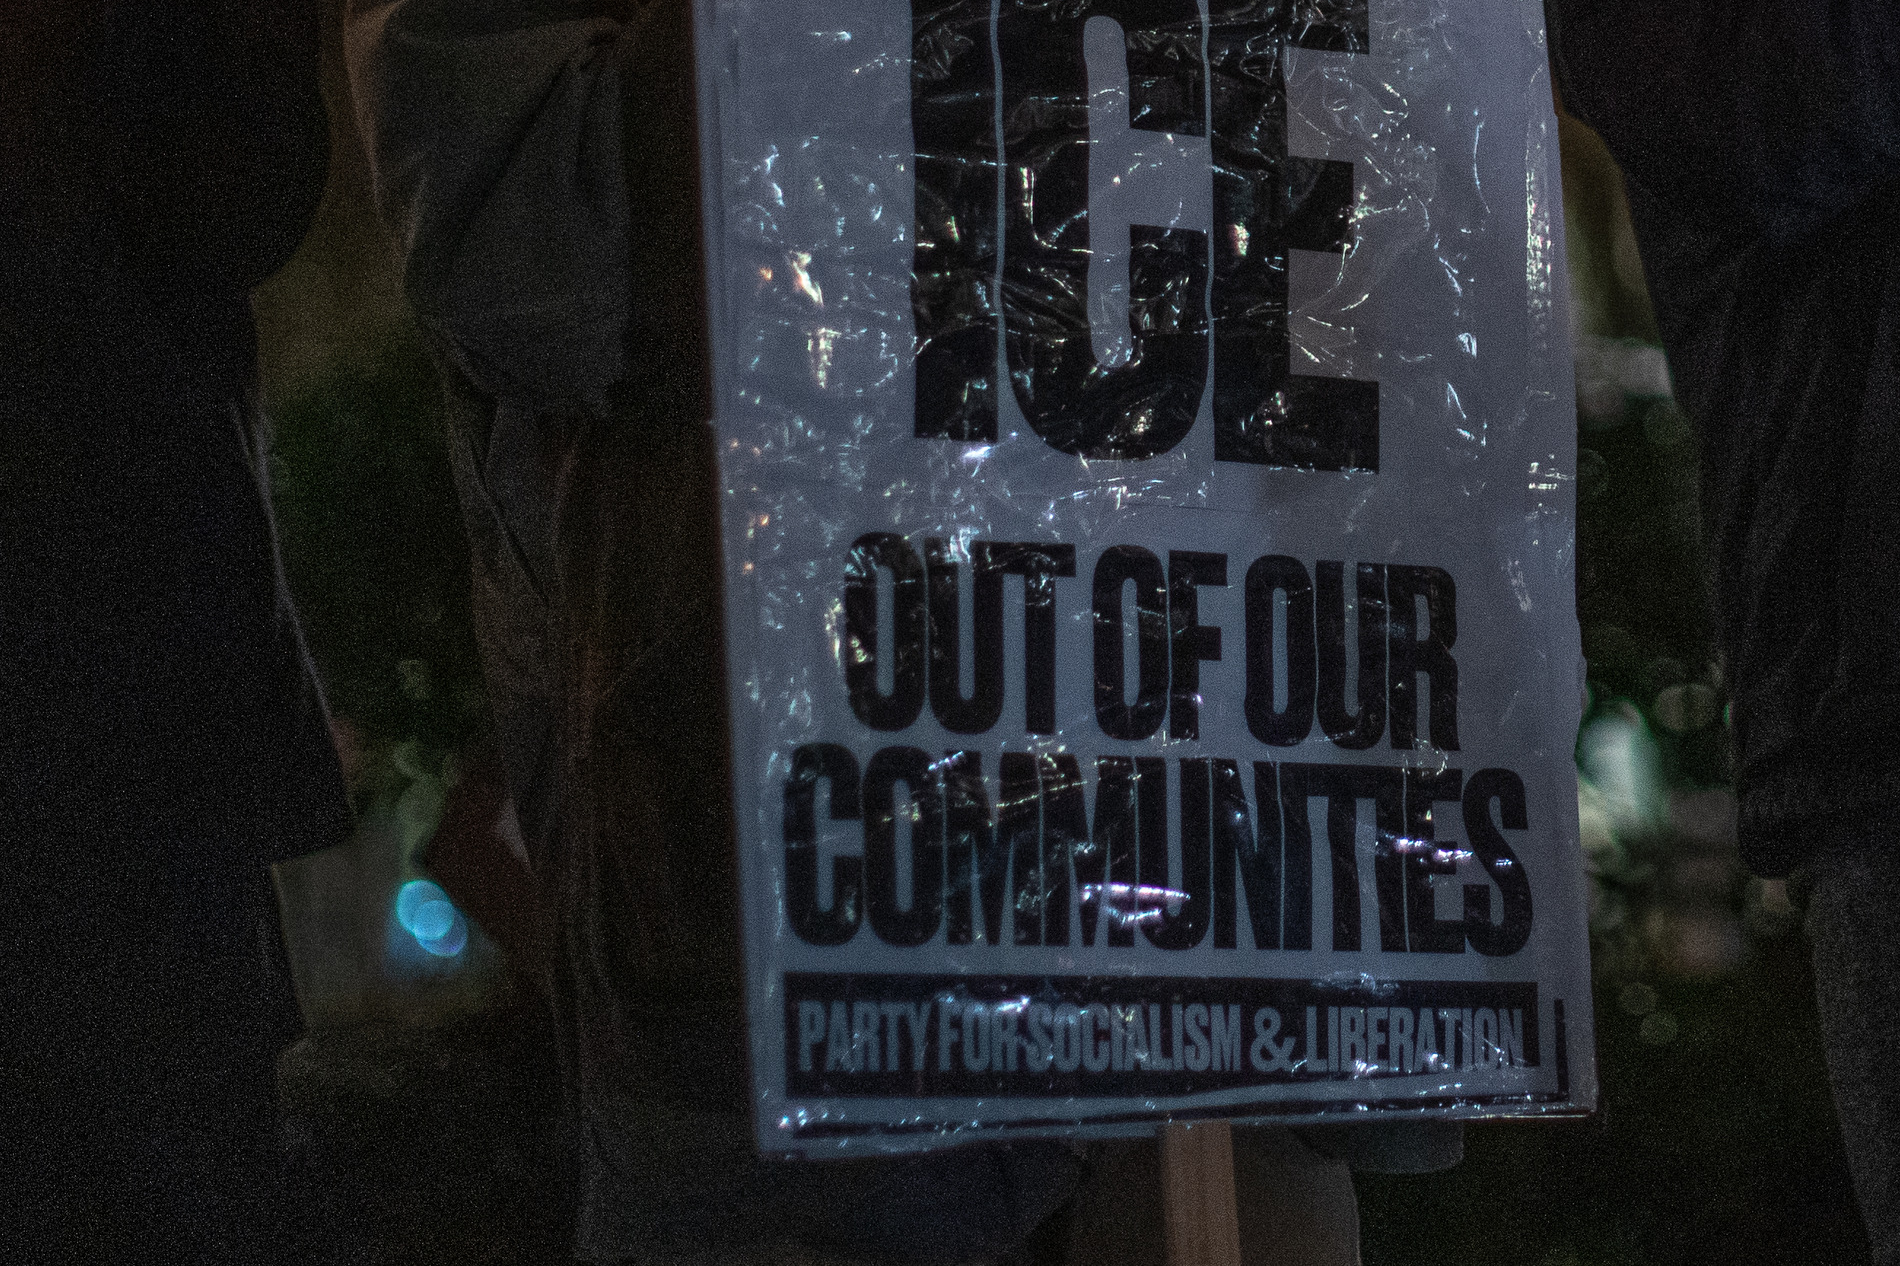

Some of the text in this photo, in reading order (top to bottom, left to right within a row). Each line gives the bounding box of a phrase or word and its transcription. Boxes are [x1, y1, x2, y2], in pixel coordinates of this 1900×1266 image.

[844, 533, 1461, 752] OUT OF OUR
[783, 742, 1534, 958] COMMUNITIES
[798, 996, 1524, 1074] PARTY FOR SOCIALISM & LIBERATION
